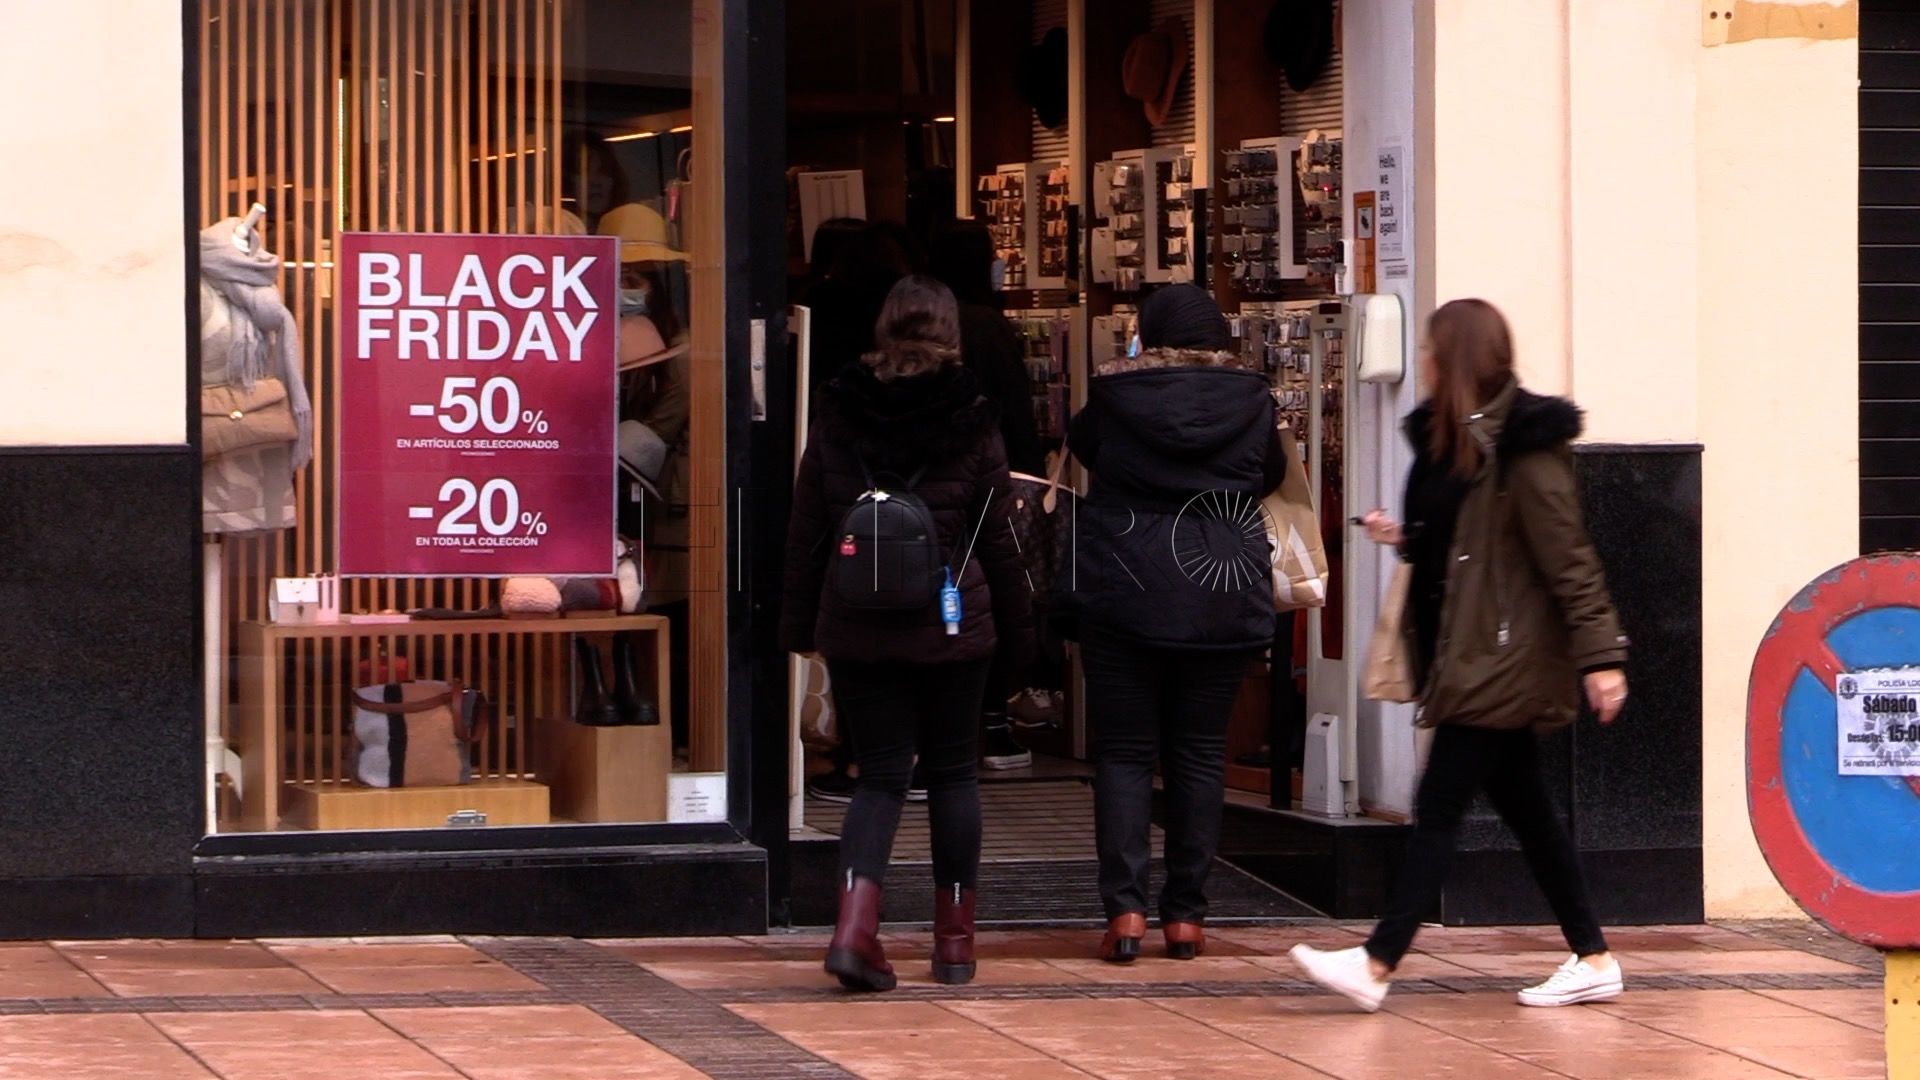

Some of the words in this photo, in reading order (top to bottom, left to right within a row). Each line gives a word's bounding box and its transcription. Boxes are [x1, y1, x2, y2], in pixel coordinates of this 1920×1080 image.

[358, 252, 599, 310] BLACK
[357, 308, 599, 362] FRIDAY
[409, 376, 549, 434] -50%
[397, 439, 411, 448] EN
[413, 437, 471, 449] ARTÍCULOS
[473, 439, 559, 449] SELECCIONADOS
[408, 477, 548, 536] -20%
[416, 537, 430, 546] EN
[432, 537, 461, 546] TODA
[463, 537, 476, 546] LA
[478, 535, 538, 546] COLECCIÓN
[1863, 694, 1917, 713] Sábado
